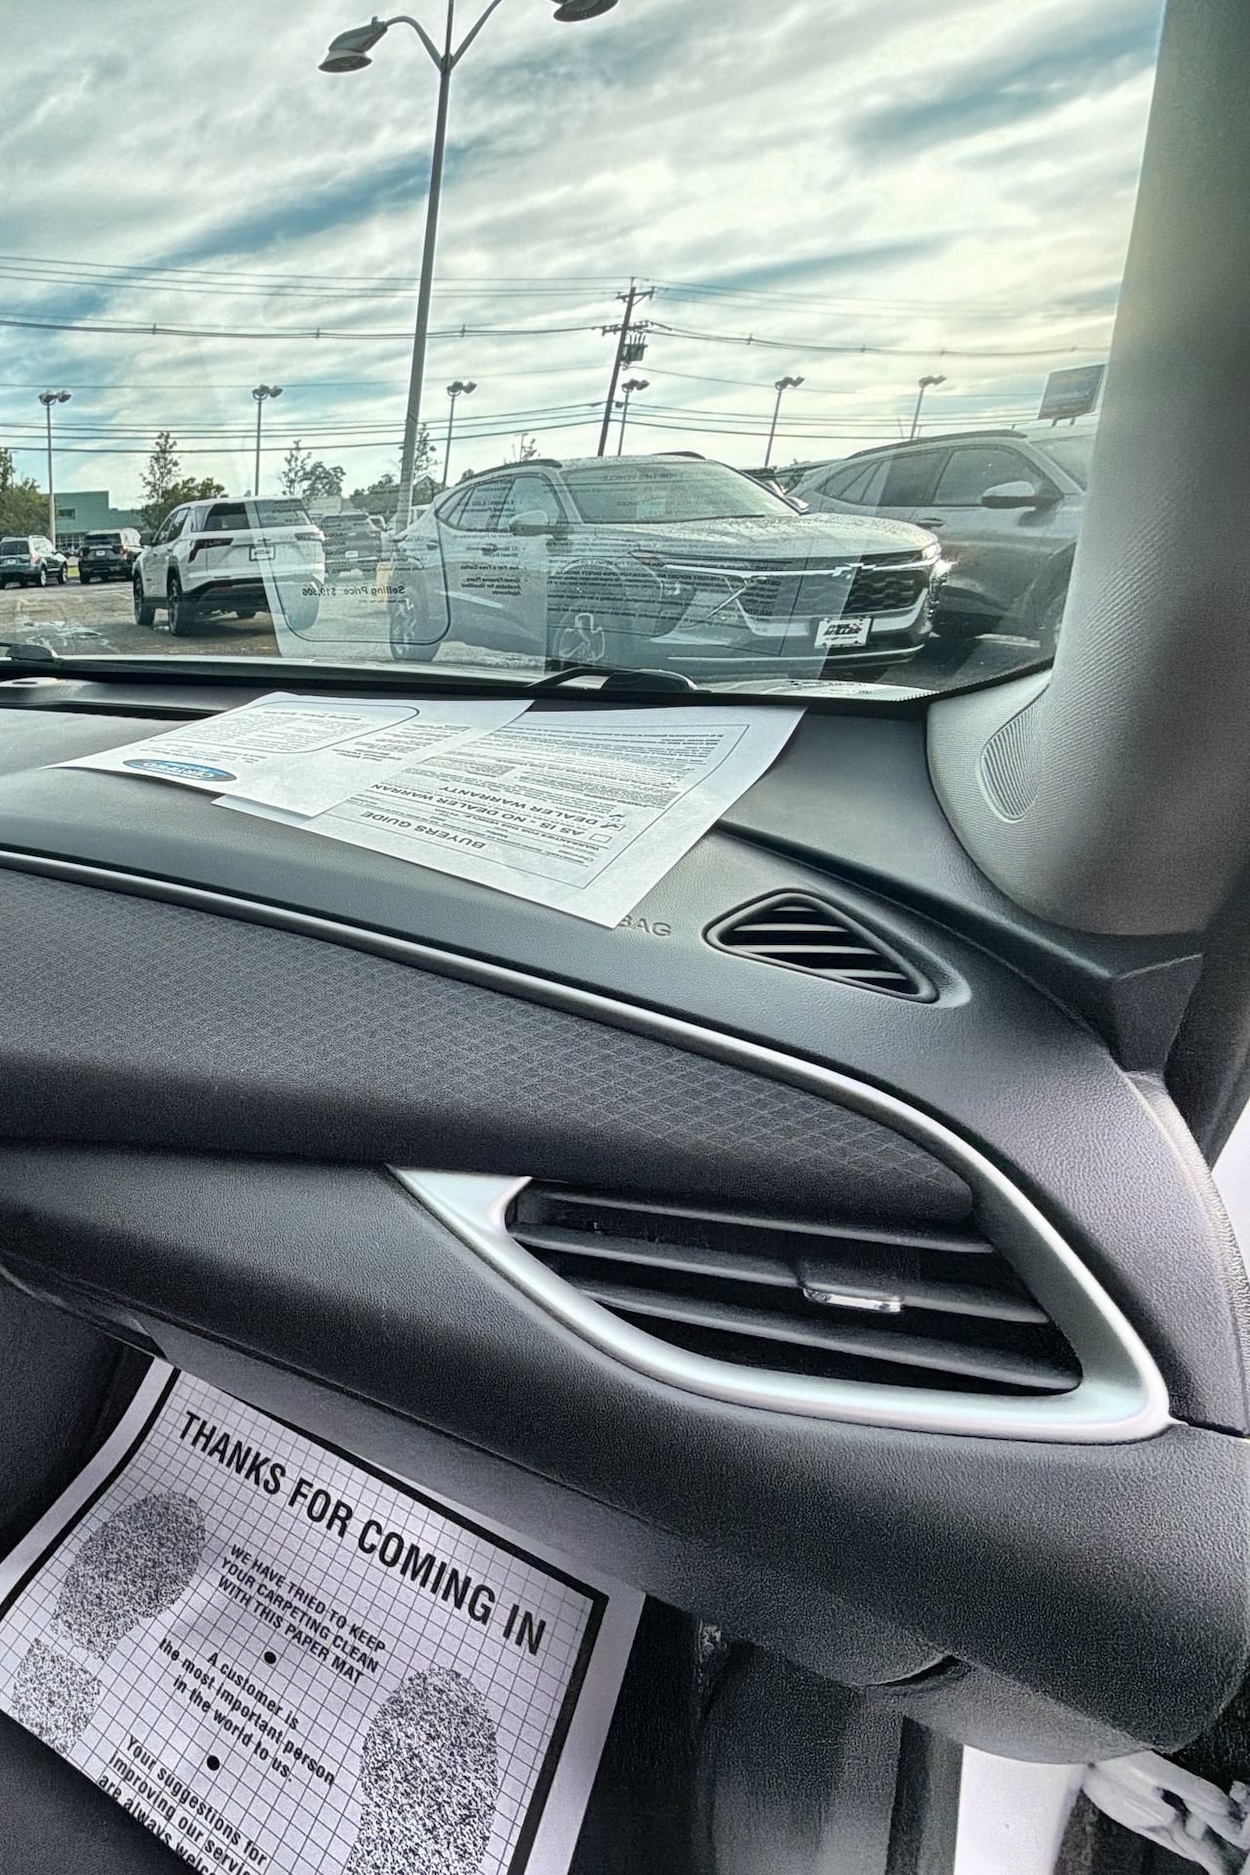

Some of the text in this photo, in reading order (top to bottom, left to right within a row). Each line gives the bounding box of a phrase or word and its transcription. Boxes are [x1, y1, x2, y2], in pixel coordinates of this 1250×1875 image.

[370, 784, 434, 802] WARRAN
[438, 787, 527, 809] WARRANTY
[436, 798, 499, 816] DEALER
[501, 813, 527, 823] NO
[530, 806, 599, 825] DEALER
[360, 812, 413, 828] GUIDE
[539, 822, 557, 831] IS
[560, 828, 586, 836] AS
[413, 825, 487, 850] BUYERS
[180, 1410, 547, 1657] THANKS FOR COMING IN
[230, 1544, 387, 1653] WE HAVE TRIED TO KEEP
[221, 1556, 380, 1674] YOUR CARPETING CLEAN
[218, 1575, 366, 1686] WITH THIS PAPER MAT
[207, 1651, 300, 1731] A customer is
[158, 1637, 336, 1787] the most important person
[172, 1674, 293, 1783] in the world to us.
[99, 1775, 123, 1800] are
[109, 1749, 177, 1822] improving
[178, 1816, 205, 1844] our
[125, 1734, 268, 1867] Your suggestions for
